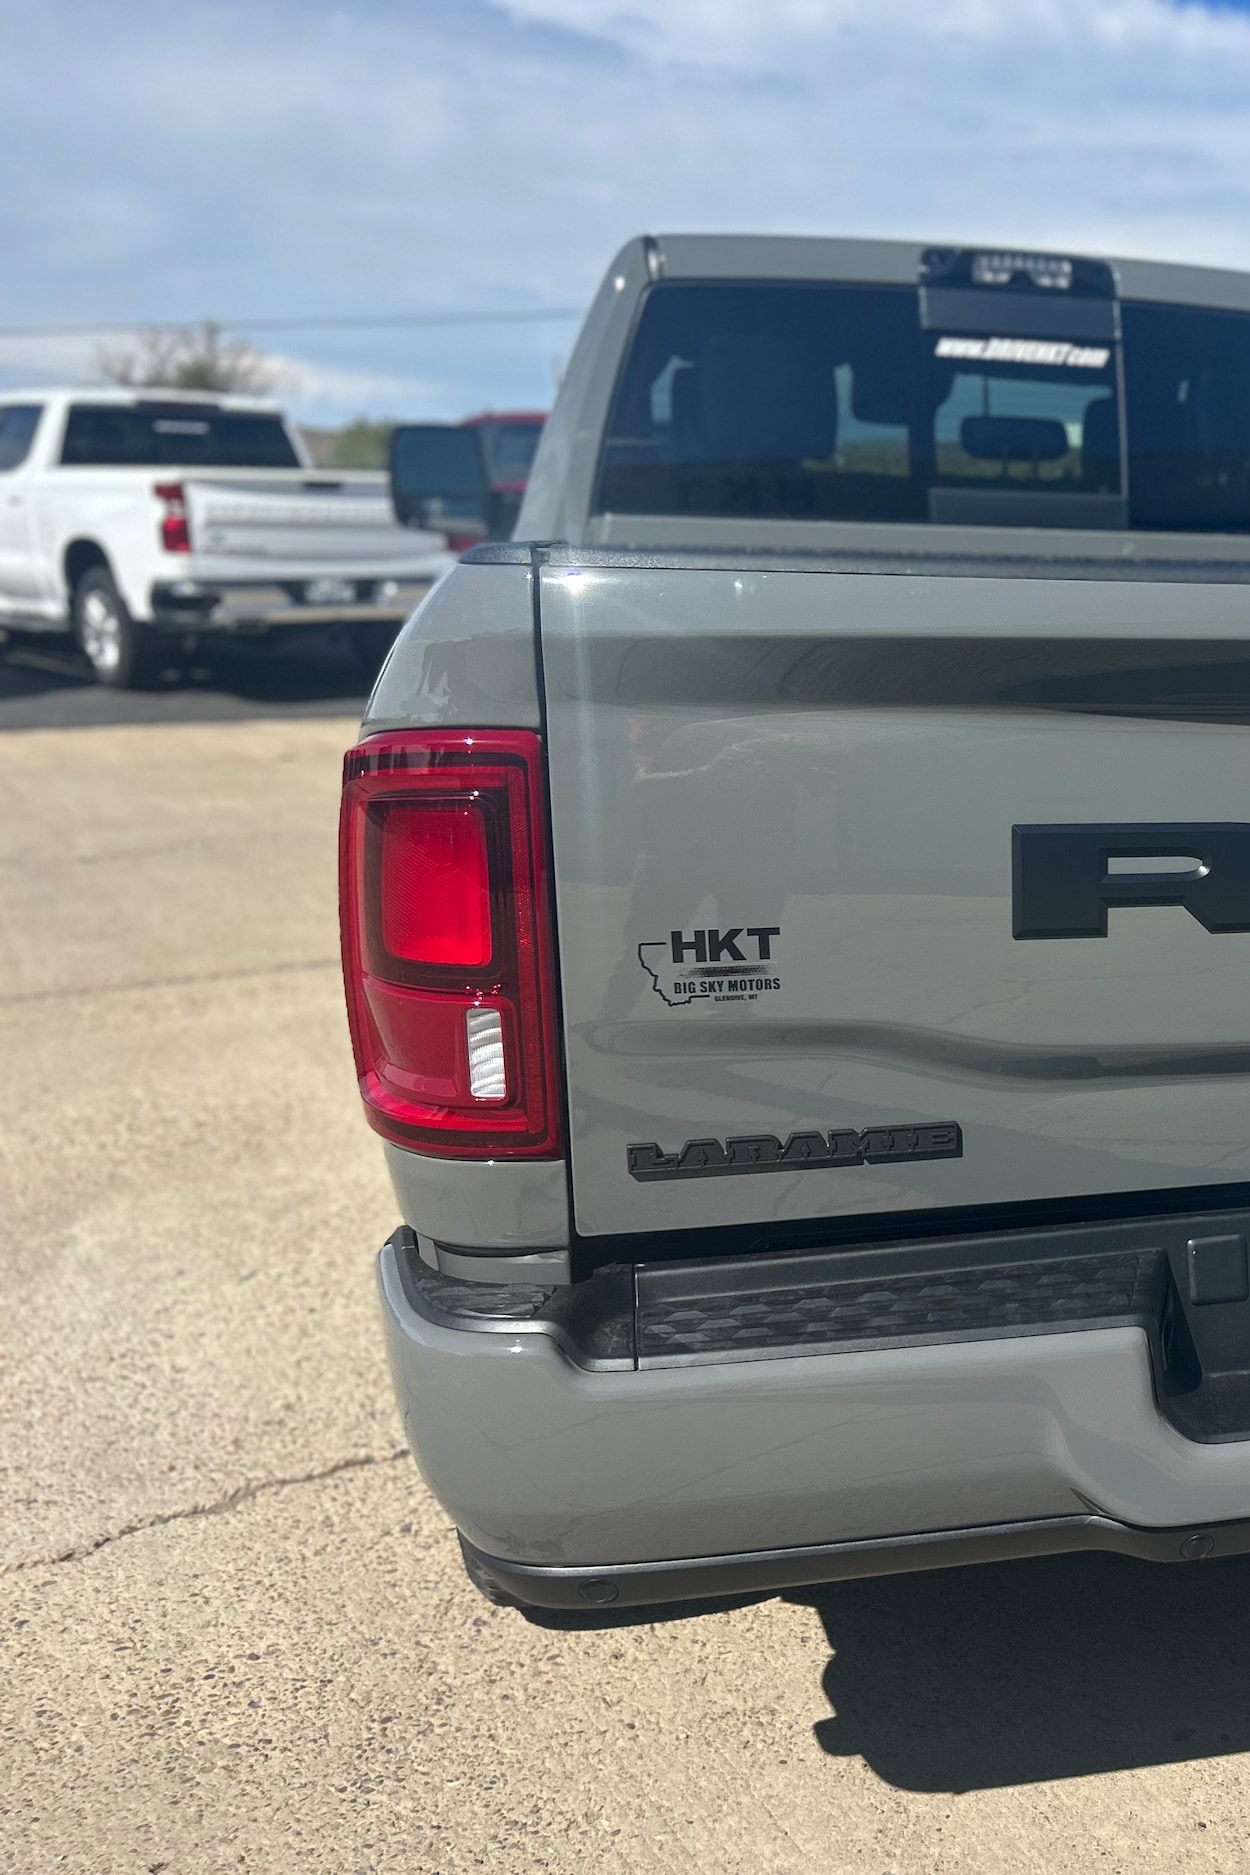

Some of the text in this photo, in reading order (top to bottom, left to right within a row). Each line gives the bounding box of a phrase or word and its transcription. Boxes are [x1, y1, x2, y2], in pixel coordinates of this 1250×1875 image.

[671, 927, 781, 963] HKT
[674, 978, 781, 994] BIG SKY MOTORS
[627, 1121, 964, 1182] LARAMIE
